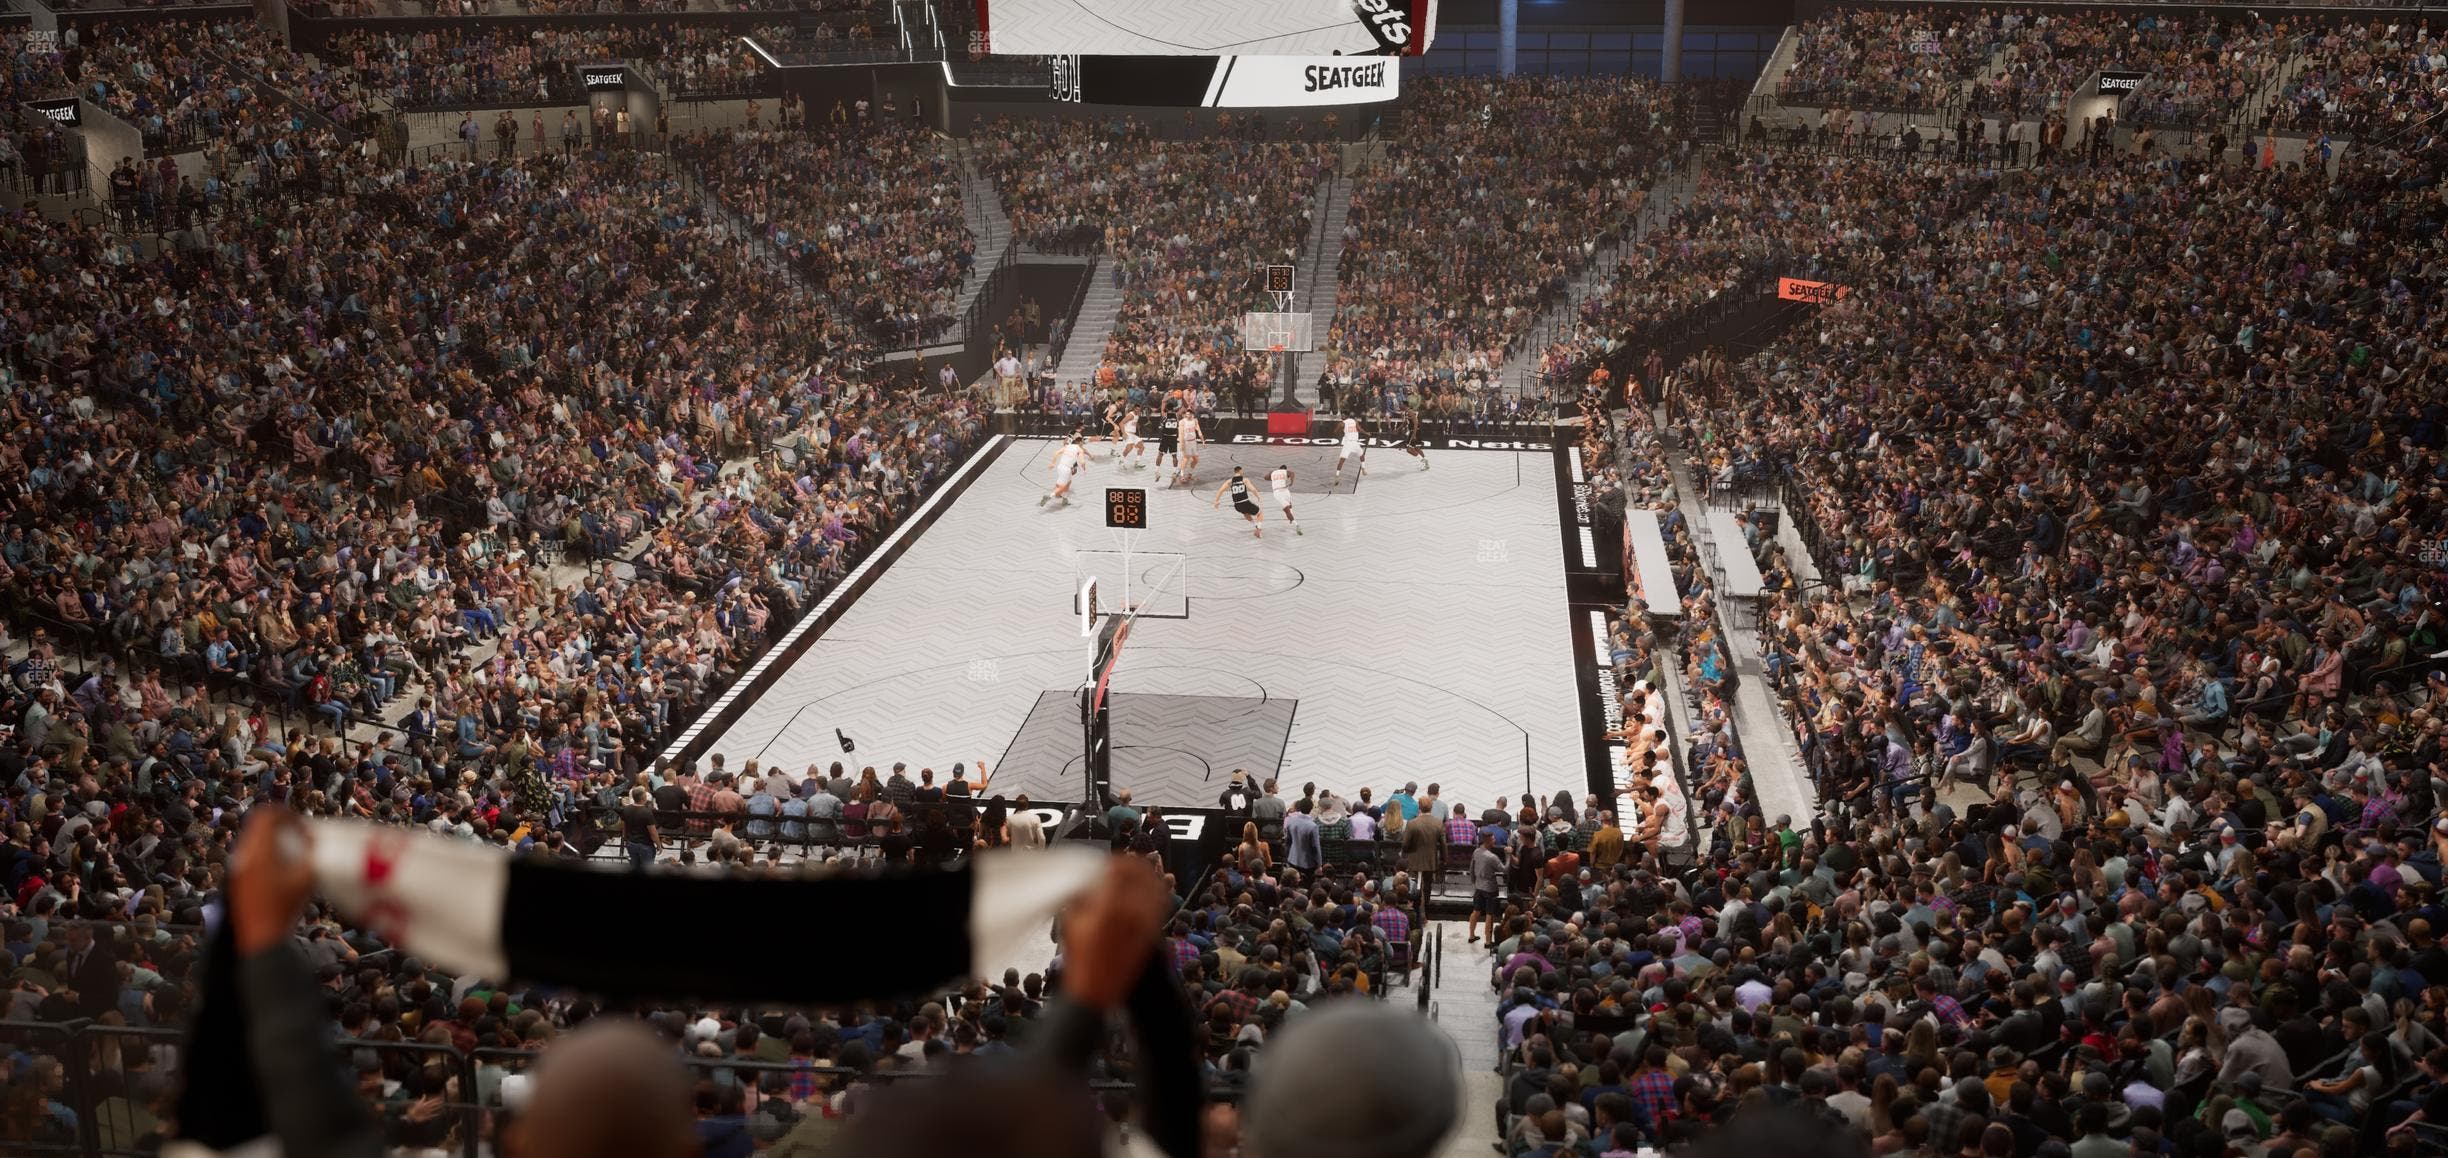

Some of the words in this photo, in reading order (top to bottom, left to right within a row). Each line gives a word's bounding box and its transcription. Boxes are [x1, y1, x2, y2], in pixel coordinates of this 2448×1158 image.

[585, 73, 624, 86] SEATGEEK
[1304, 60, 1386, 92] SEATGEEK
[37, 105, 76, 120] ATGEEK
[1788, 282, 1837, 299] SEATGEE
